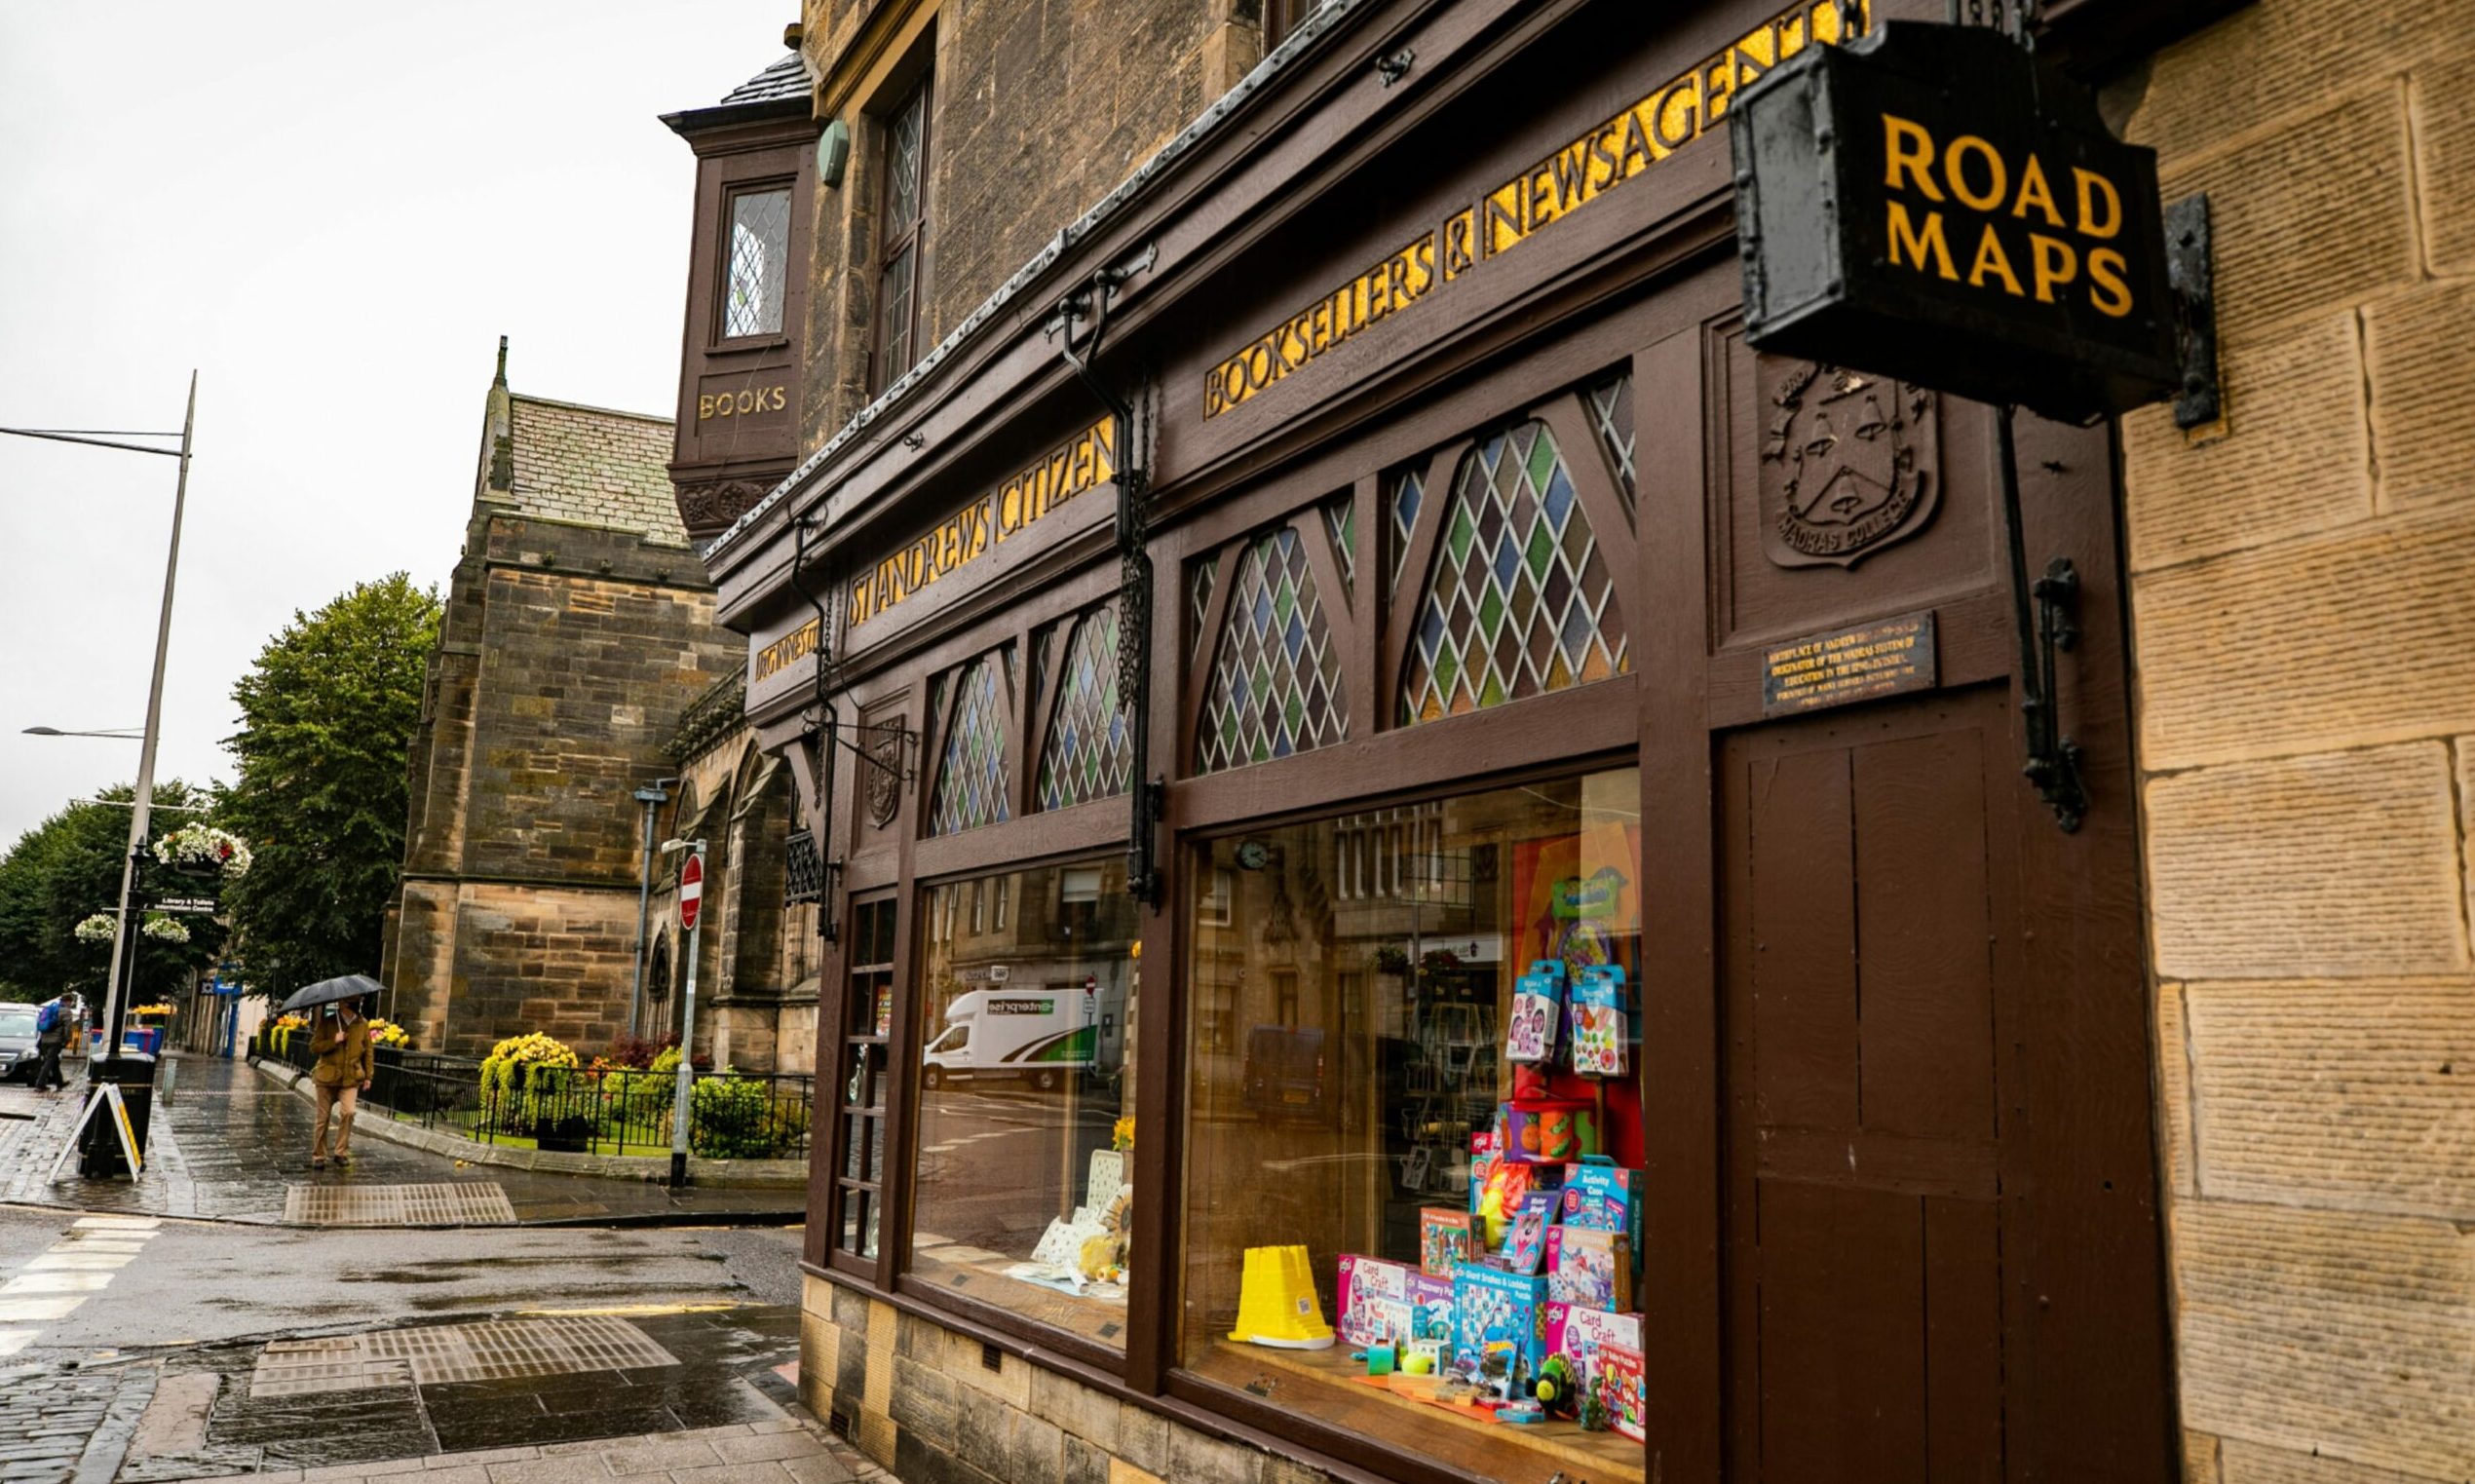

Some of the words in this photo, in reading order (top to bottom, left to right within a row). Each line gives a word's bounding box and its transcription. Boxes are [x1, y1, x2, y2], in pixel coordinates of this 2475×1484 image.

[1882, 112, 2122, 239] ROAD
[1206, 234, 1435, 419] BOOKSELLERS
[1446, 212, 1472, 278] &
[1483, 0, 1863, 258] NEWSAGENT
[1886, 200, 2134, 318] MAPS
[700, 386, 786, 419] BOOKS
[850, 570, 873, 628] ST
[876, 493, 991, 614] ANDREWS
[999, 414, 1117, 538] CITIZEN
[1778, 515, 1840, 552] MADRAS
[162, 897, 185, 906] Library
[1581, 1174, 1610, 1187] Activity
[1586, 1185, 1604, 1197] Case
[1363, 1262, 1380, 1276] Card
[1371, 1275, 1389, 1290] Craft
[1580, 1311, 1602, 1328] Card
[1591, 1326, 1616, 1344] Craft
